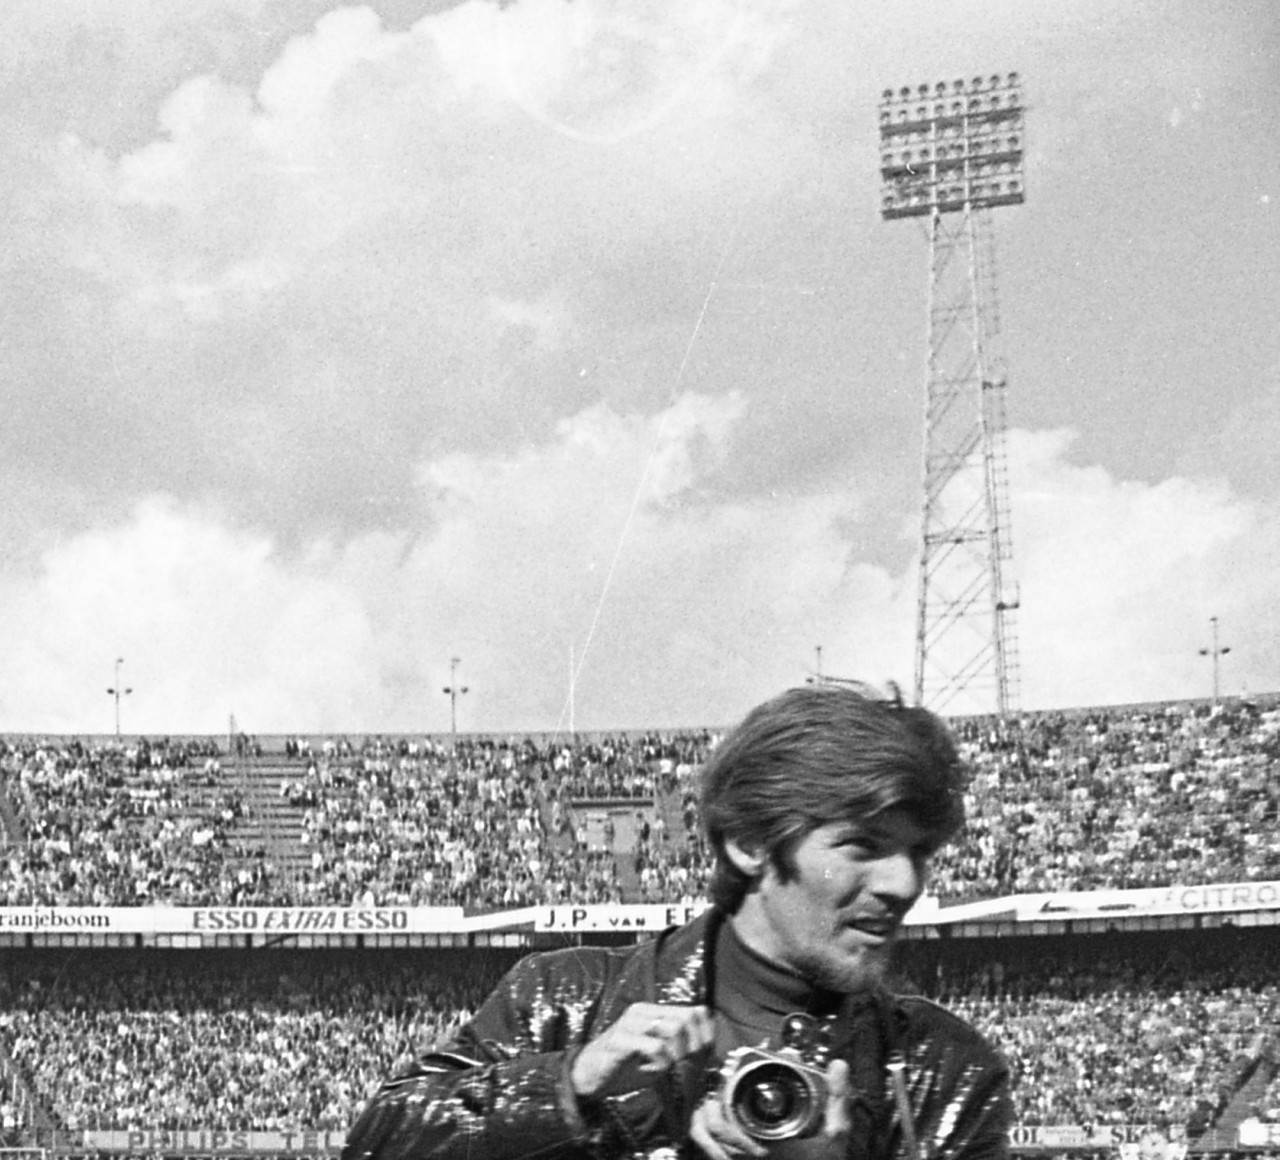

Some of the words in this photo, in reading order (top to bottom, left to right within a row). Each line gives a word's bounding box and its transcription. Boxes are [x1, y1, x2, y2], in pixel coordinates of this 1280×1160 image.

[193, 910, 258, 929] ESSO
[263, 910, 338, 929] EXTRA
[343, 910, 408, 929] ESSO
[128, 1131, 248, 1150] PHILIPS
